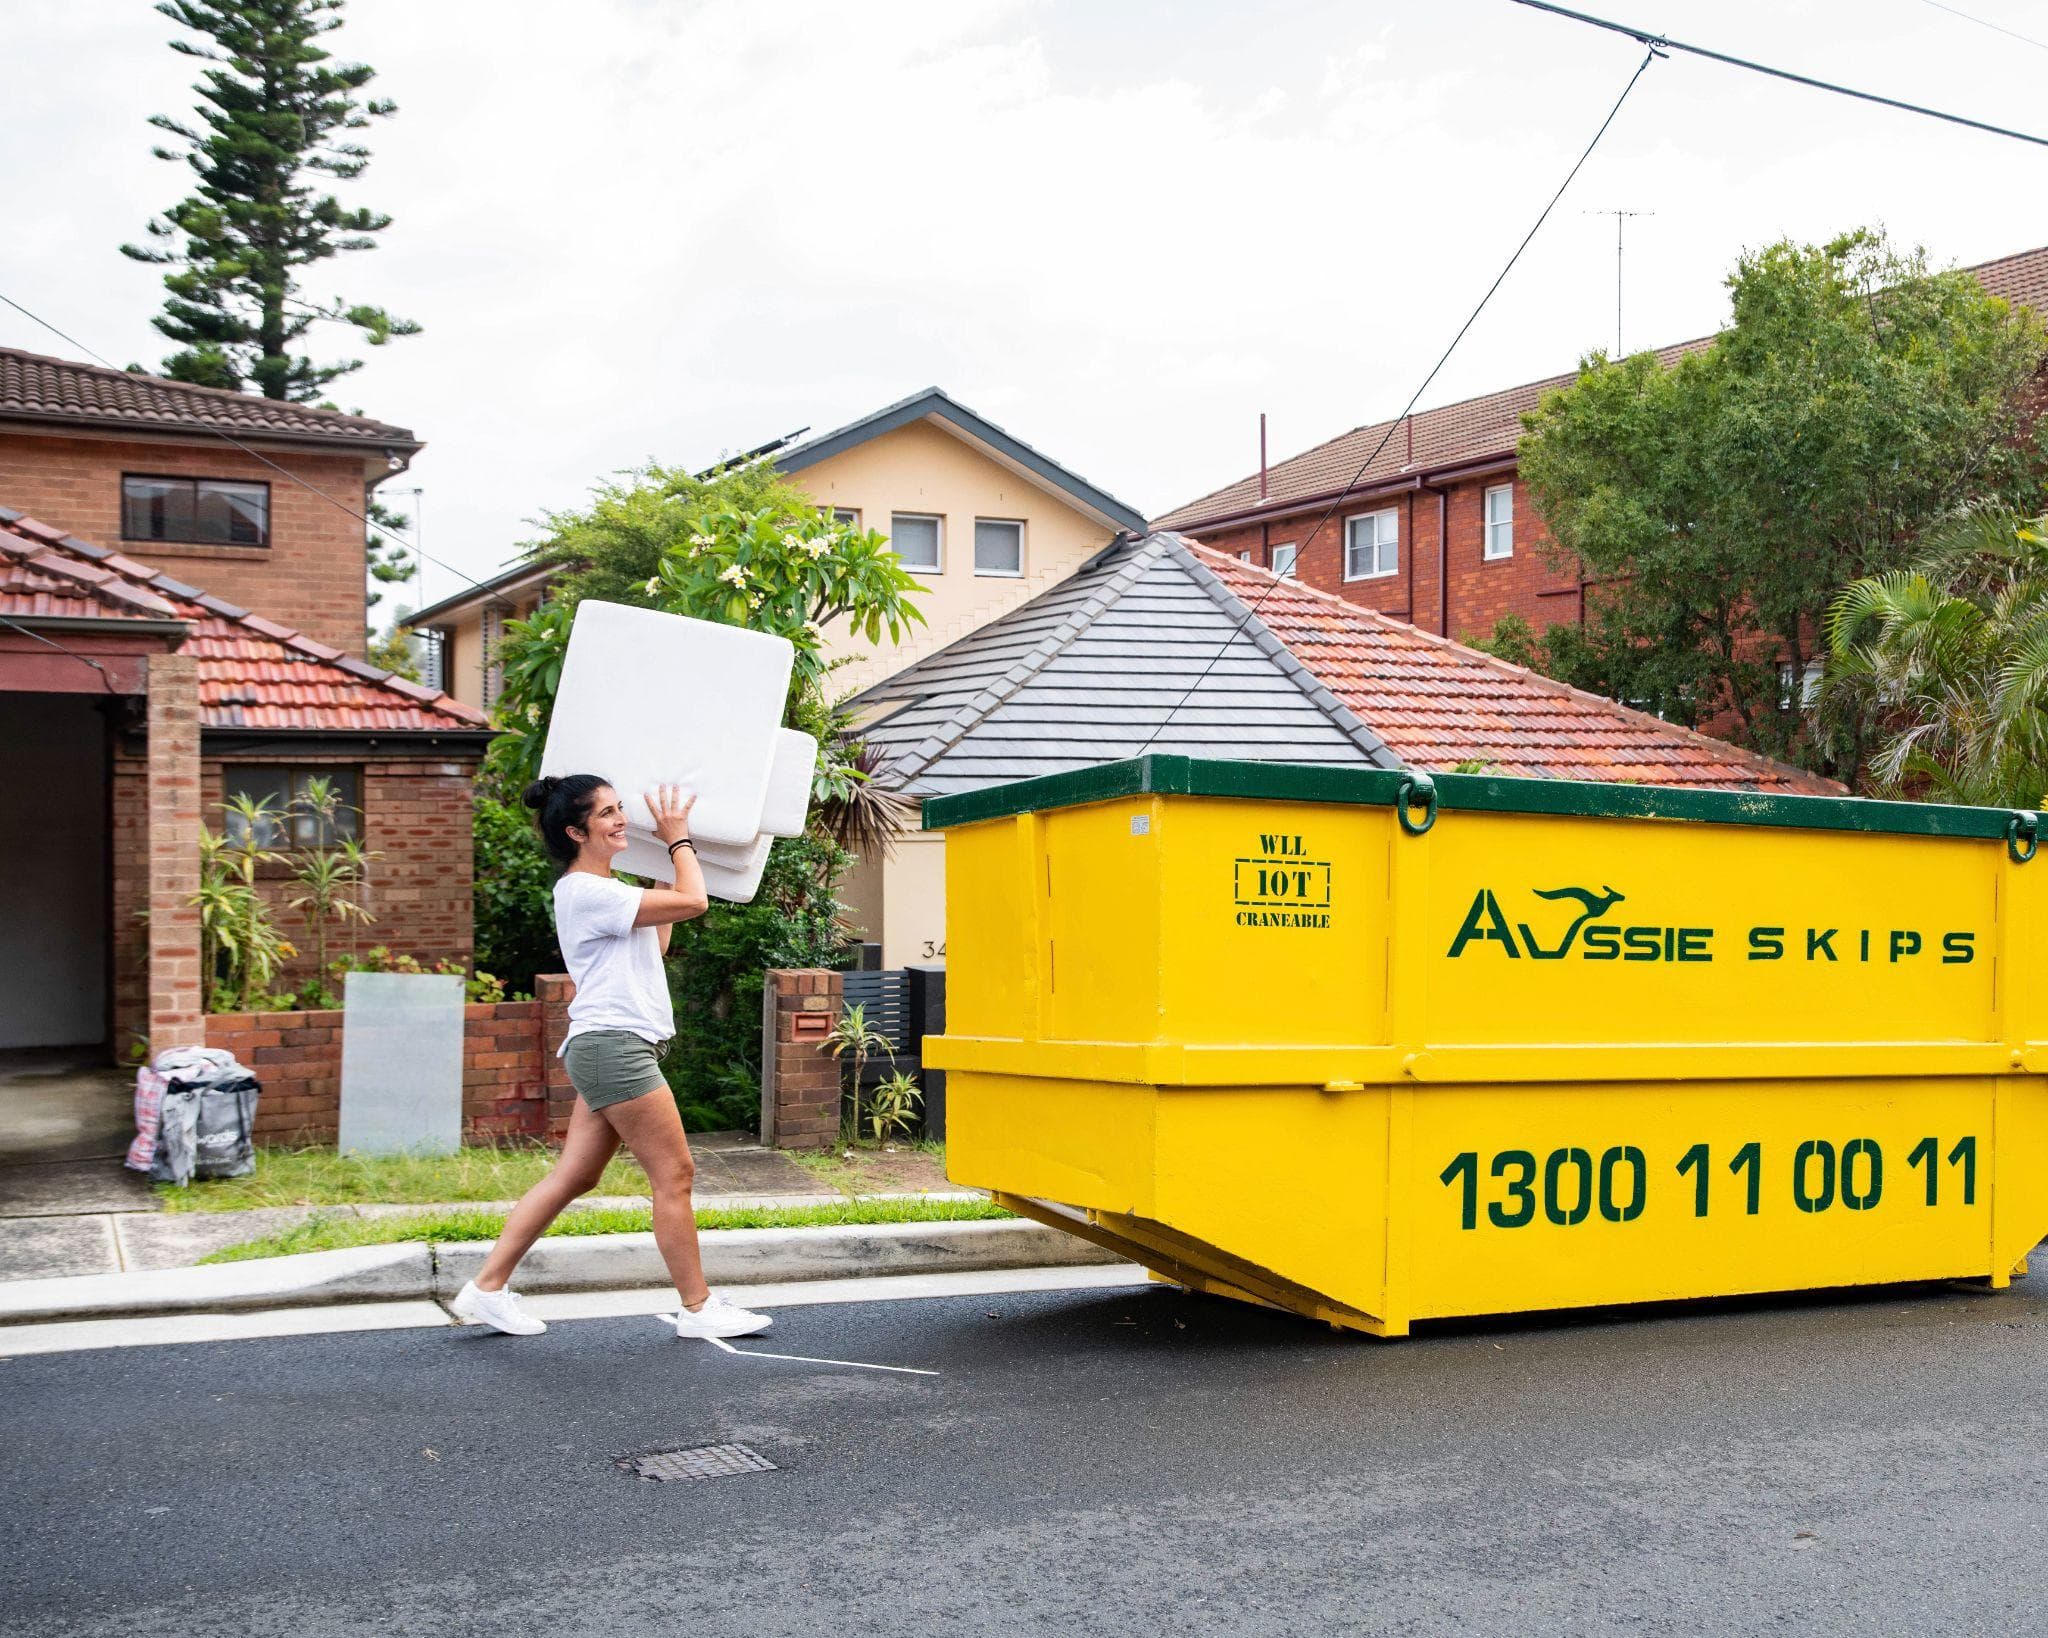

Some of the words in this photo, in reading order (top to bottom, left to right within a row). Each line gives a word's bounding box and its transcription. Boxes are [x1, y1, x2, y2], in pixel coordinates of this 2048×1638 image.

[1260, 834, 1307, 856] WLL
[1257, 869, 1312, 898] 10T
[1236, 911, 1331, 928] CRANEABLE
[1446, 885, 1714, 962] AUSSIE
[1748, 926, 1975, 964] SKIPS
[922, 941, 946, 959] 34
[1439, 1144, 1647, 1230] 1300
[1675, 1142, 1761, 1218] 11
[1793, 1138, 1883, 1214] 00
[1906, 1135, 1976, 1207] 11
